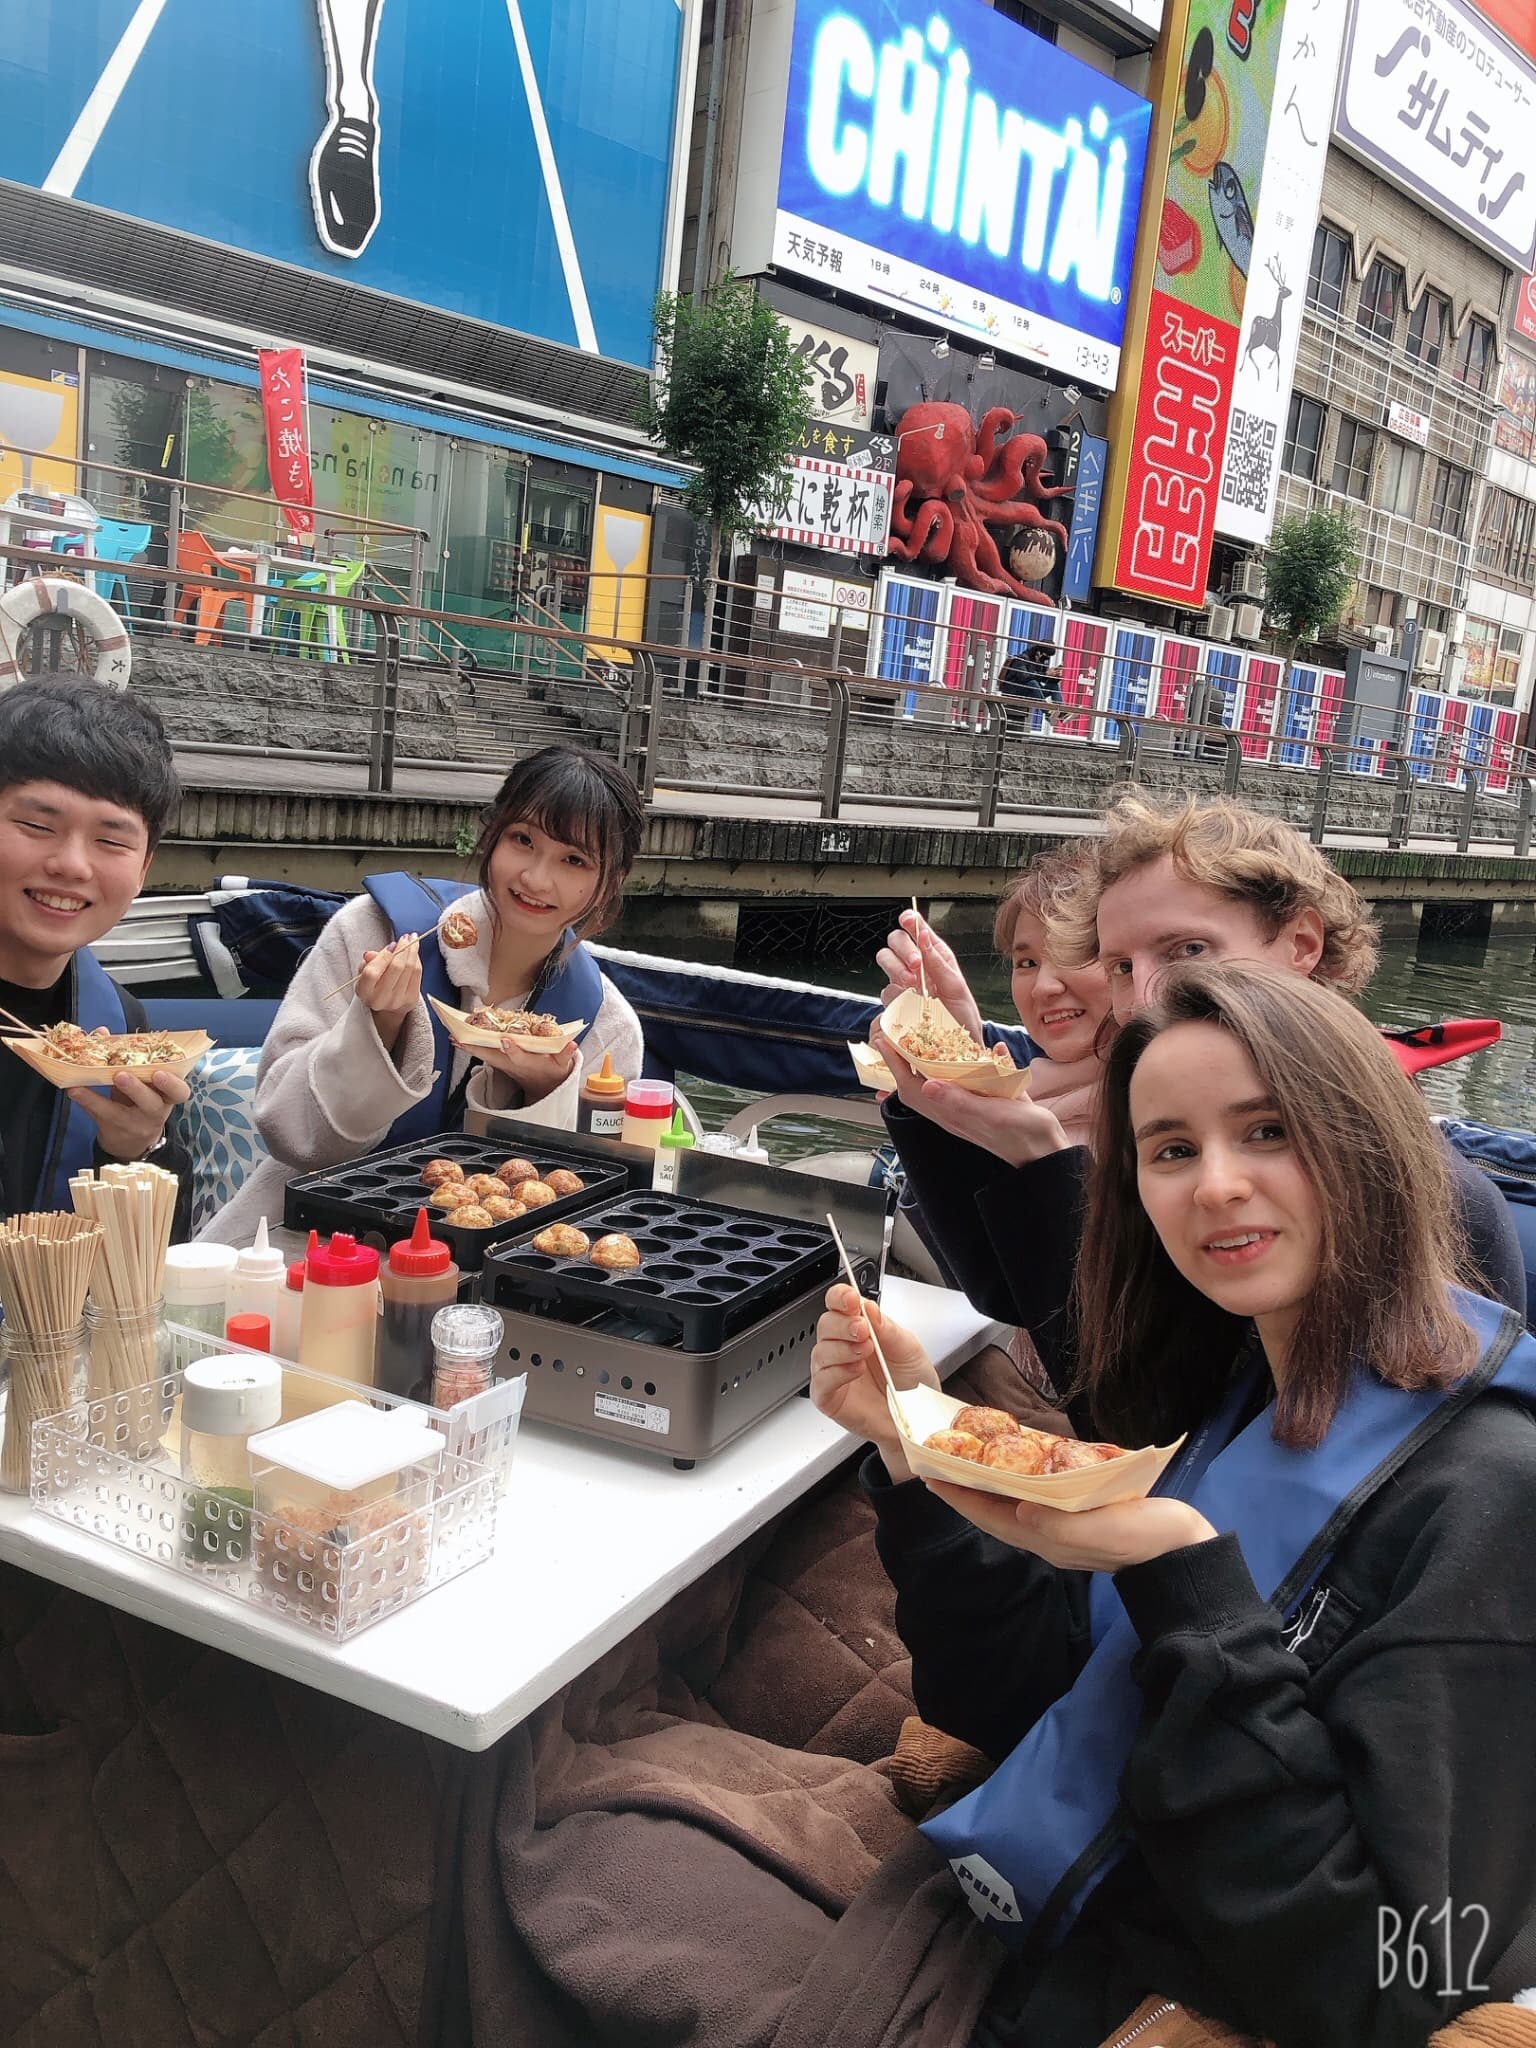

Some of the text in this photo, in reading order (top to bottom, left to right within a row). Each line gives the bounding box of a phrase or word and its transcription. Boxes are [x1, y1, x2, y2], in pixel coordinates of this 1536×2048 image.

[787, 231, 843, 274] 天気予報
[919, 279, 941, 295] 24時
[1160, 311, 1226, 366] スーパー
[874, 456, 893, 471] 2F
[957, 1863, 1014, 1919] PULL
